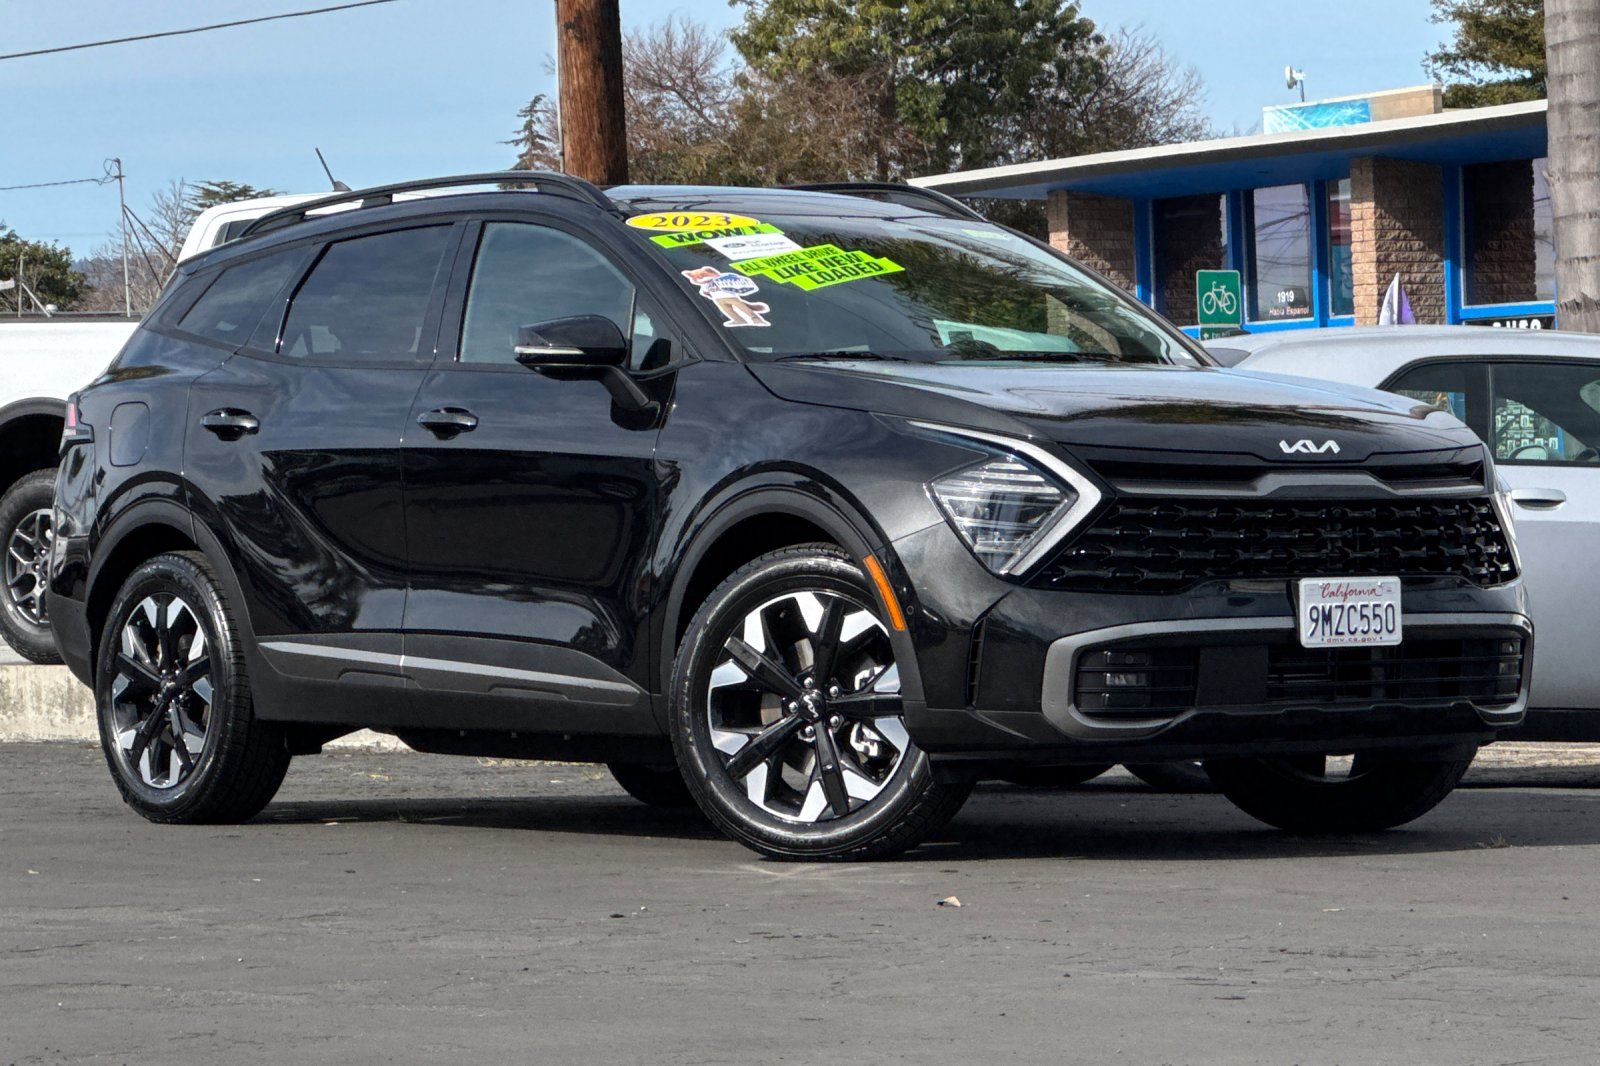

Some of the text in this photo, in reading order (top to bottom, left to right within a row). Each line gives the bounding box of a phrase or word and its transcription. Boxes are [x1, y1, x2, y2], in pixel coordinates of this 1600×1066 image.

[651, 215, 732, 227] 2023
[739, 261, 764, 273] ALL
[761, 254, 803, 269] WHEEL
[803, 247, 840, 260] DRIVE
[773, 252, 863, 279] LIKE NEW
[806, 261, 885, 284] LOADED
[1277, 290, 1295, 303] 1919
[1279, 439, 1341, 454] KIA
[1320, 582, 1382, 602] California
[1309, 603, 1396, 637] 9MZC550
